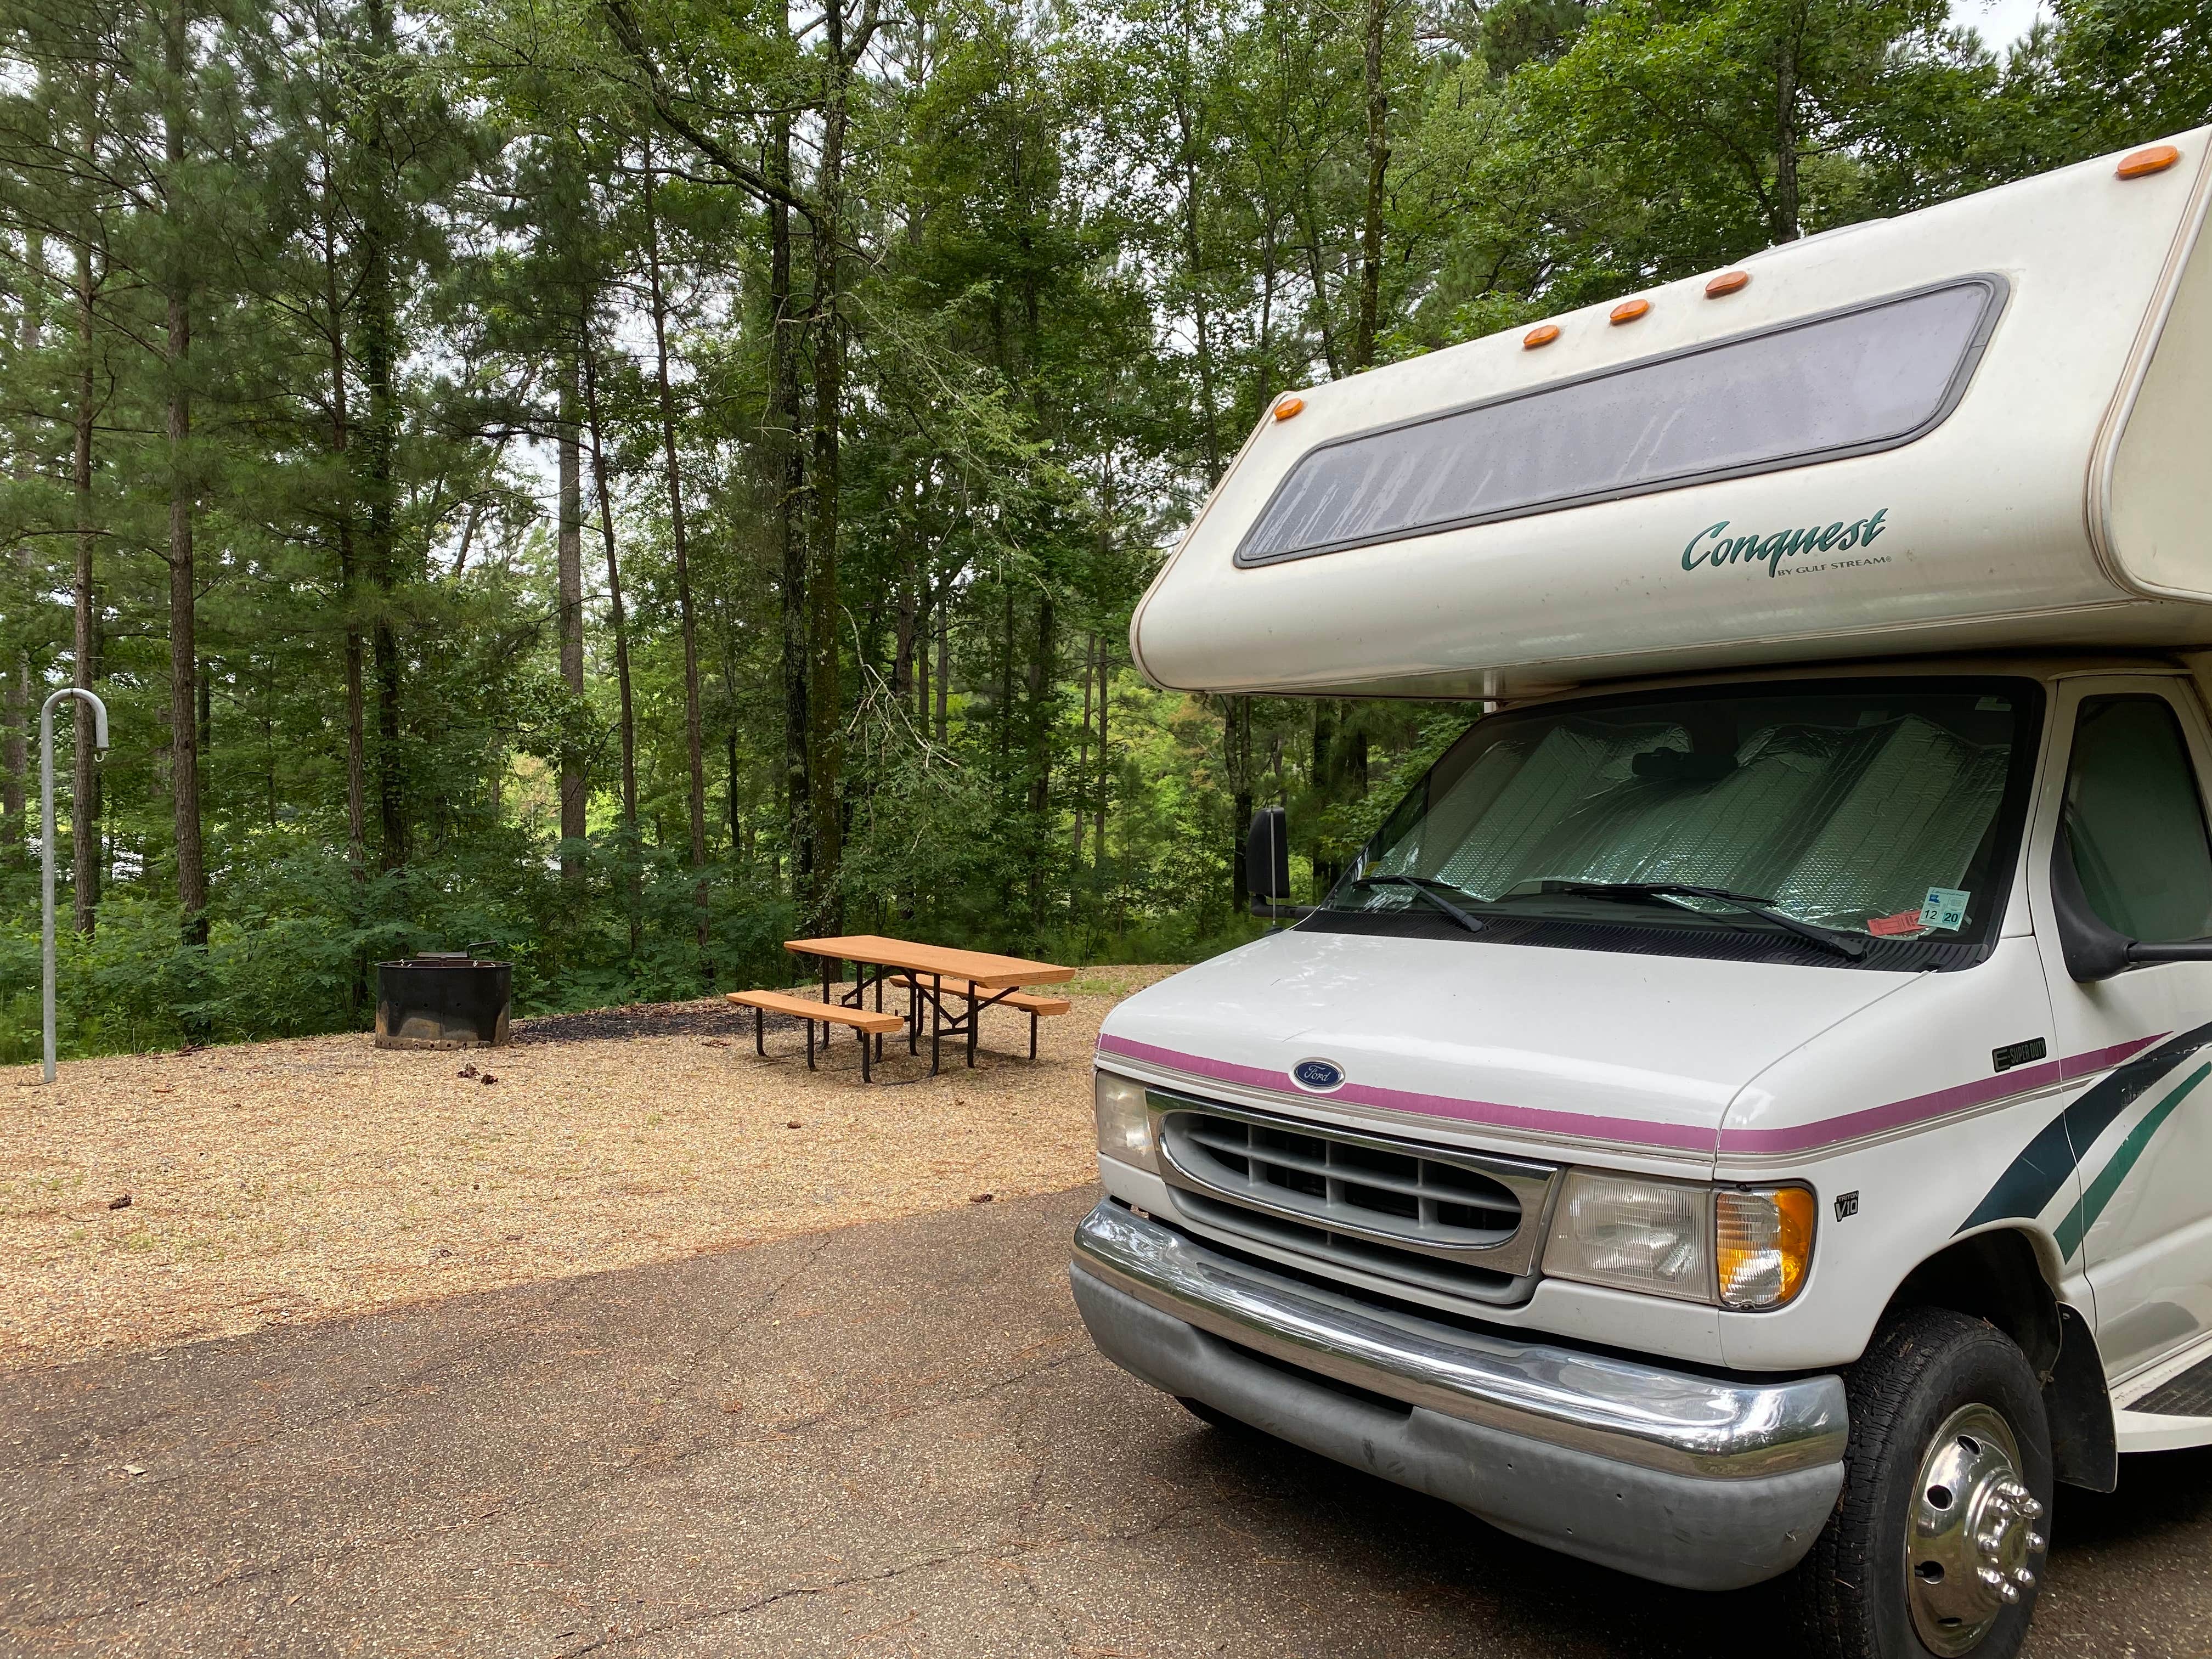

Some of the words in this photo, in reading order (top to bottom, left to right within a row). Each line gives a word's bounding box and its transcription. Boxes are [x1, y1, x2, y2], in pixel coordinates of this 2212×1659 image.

[1681, 508, 1888, 578] Conquest
[1796, 564, 1827, 573] GULF
[1925, 910, 1937, 919] 12
[1944, 912, 1958, 923] 20
[2029, 1040, 2046, 1059] DUTY
[1304, 1065, 1331, 1082] Ford
[1838, 1192, 1858, 1202] TRITON
[1836, 1199, 1858, 1221] V10
